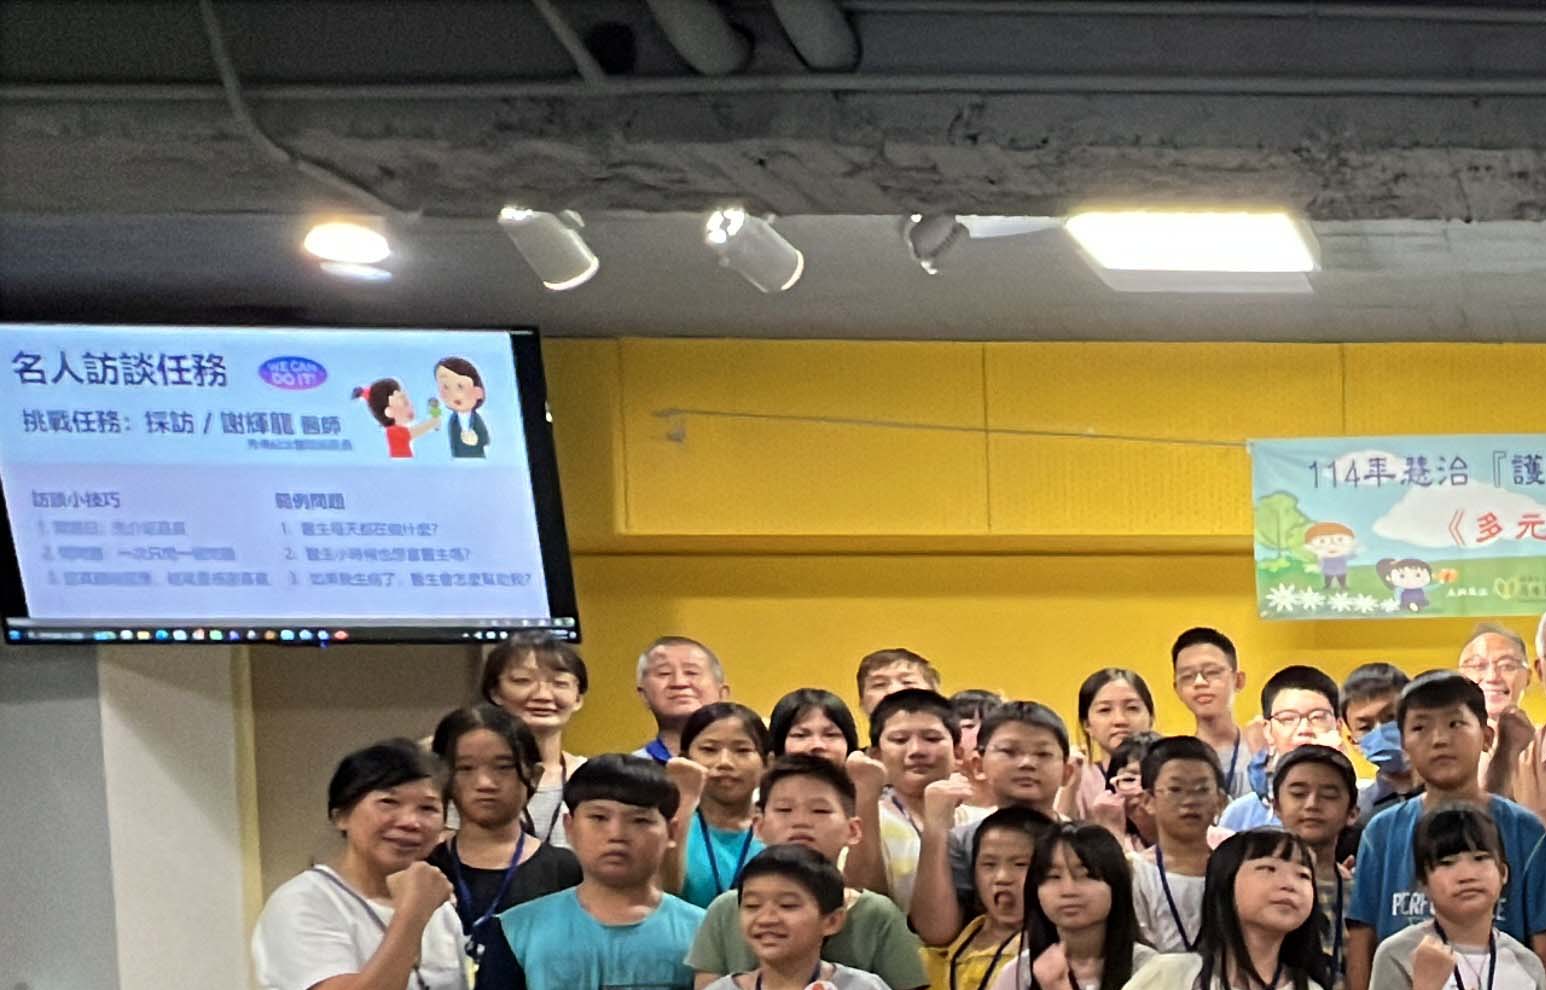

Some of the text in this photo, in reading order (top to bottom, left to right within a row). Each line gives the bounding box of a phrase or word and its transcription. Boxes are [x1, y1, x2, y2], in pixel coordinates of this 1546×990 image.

[12, 350, 227, 387] 名人訪談任務
[271, 373, 296, 386] DO
